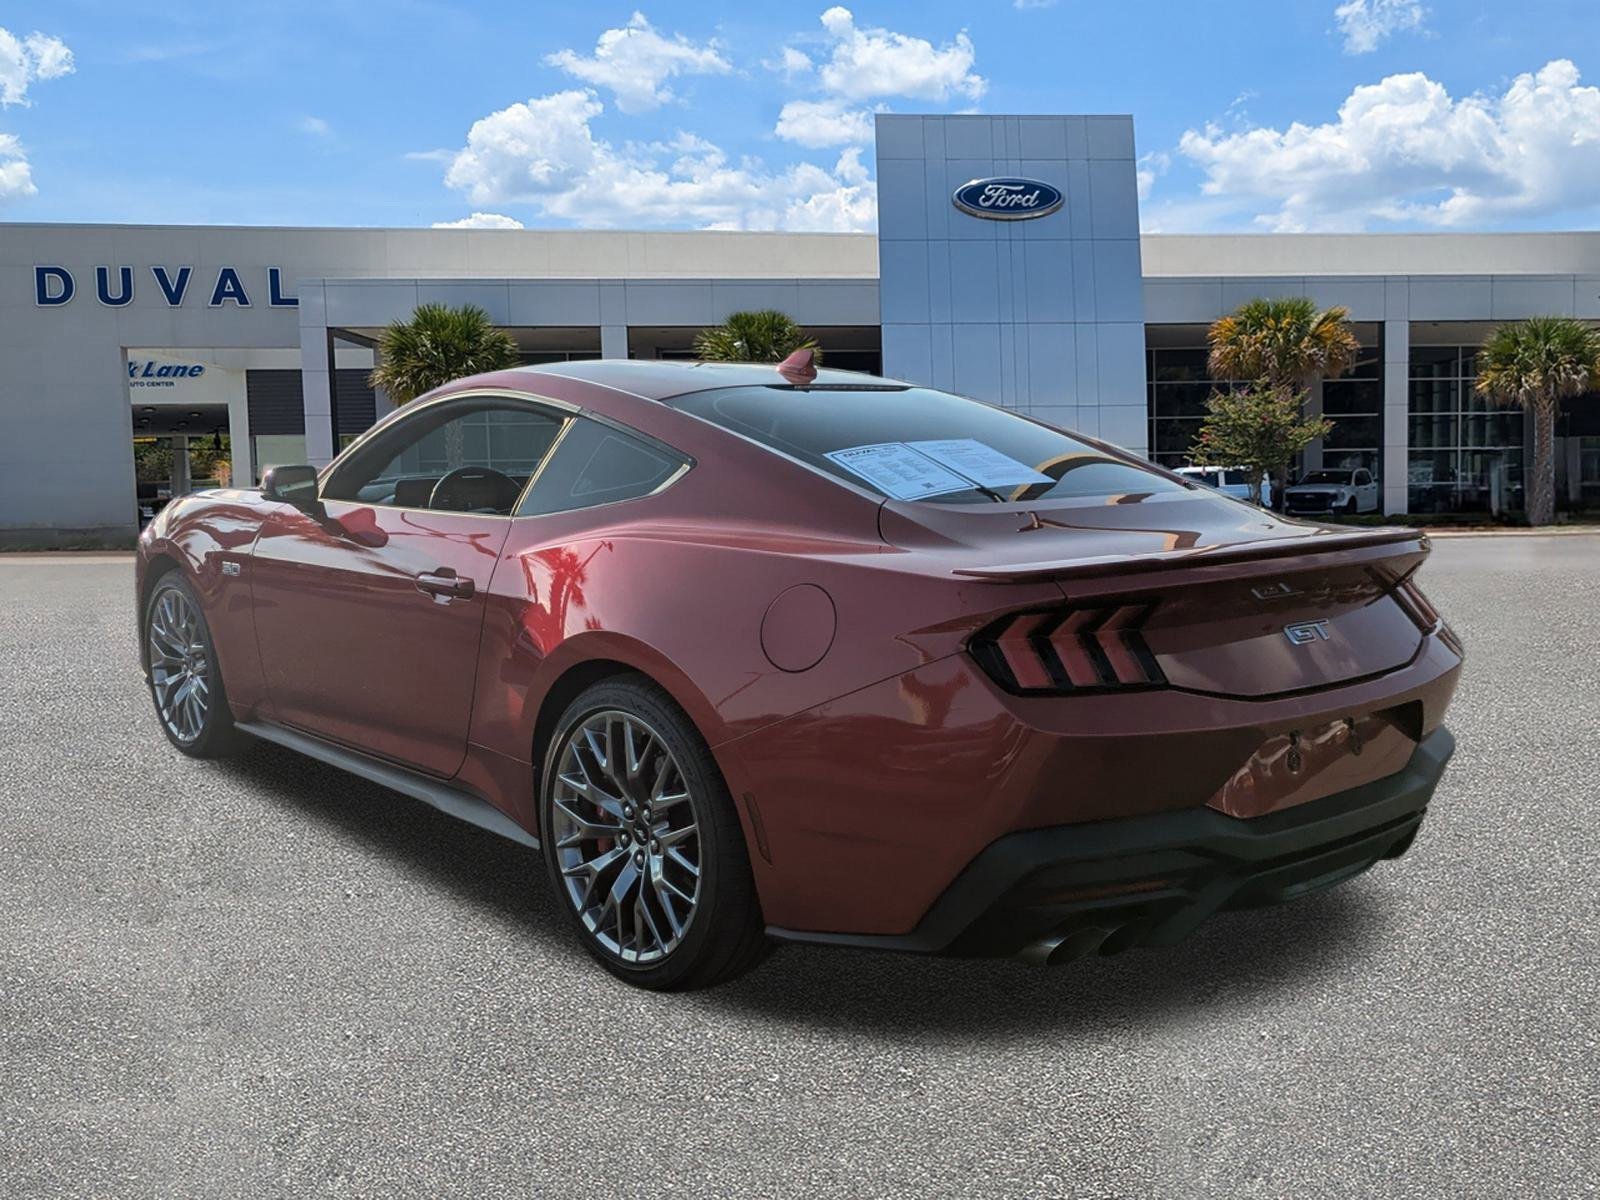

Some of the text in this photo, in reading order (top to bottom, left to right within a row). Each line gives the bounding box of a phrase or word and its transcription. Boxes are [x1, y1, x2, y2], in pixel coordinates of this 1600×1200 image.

[978, 184, 1040, 207] Ford
[33, 265, 299, 307] DUVAL
[141, 361, 205, 378] Lane
[1283, 618, 1329, 645] GT
